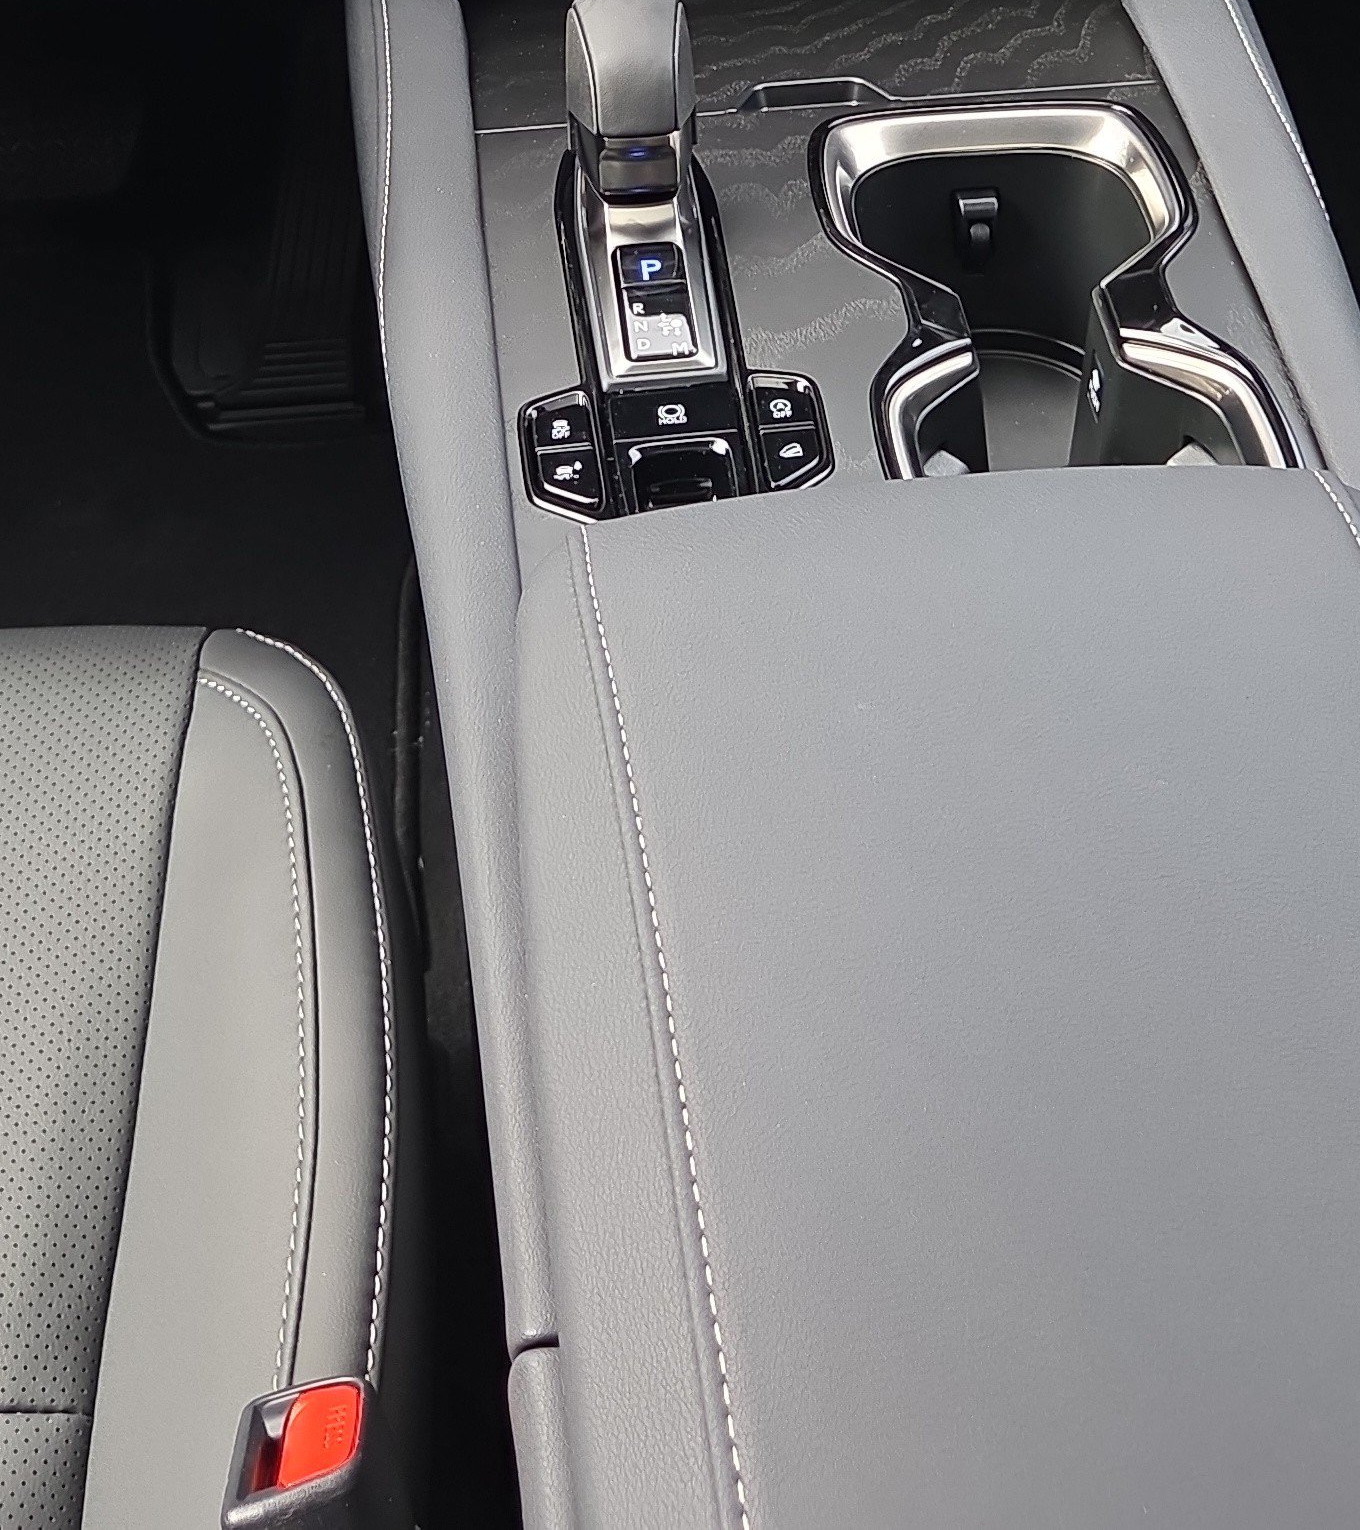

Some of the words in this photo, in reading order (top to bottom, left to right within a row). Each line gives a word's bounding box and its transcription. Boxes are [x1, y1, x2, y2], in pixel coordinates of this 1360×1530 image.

[640, 259, 662, 281] P
[632, 302, 646, 315] R
[633, 320, 649, 333] N
[636, 338, 651, 350] D
[671, 341, 690, 357] M
[658, 415, 688, 426] HOLD
